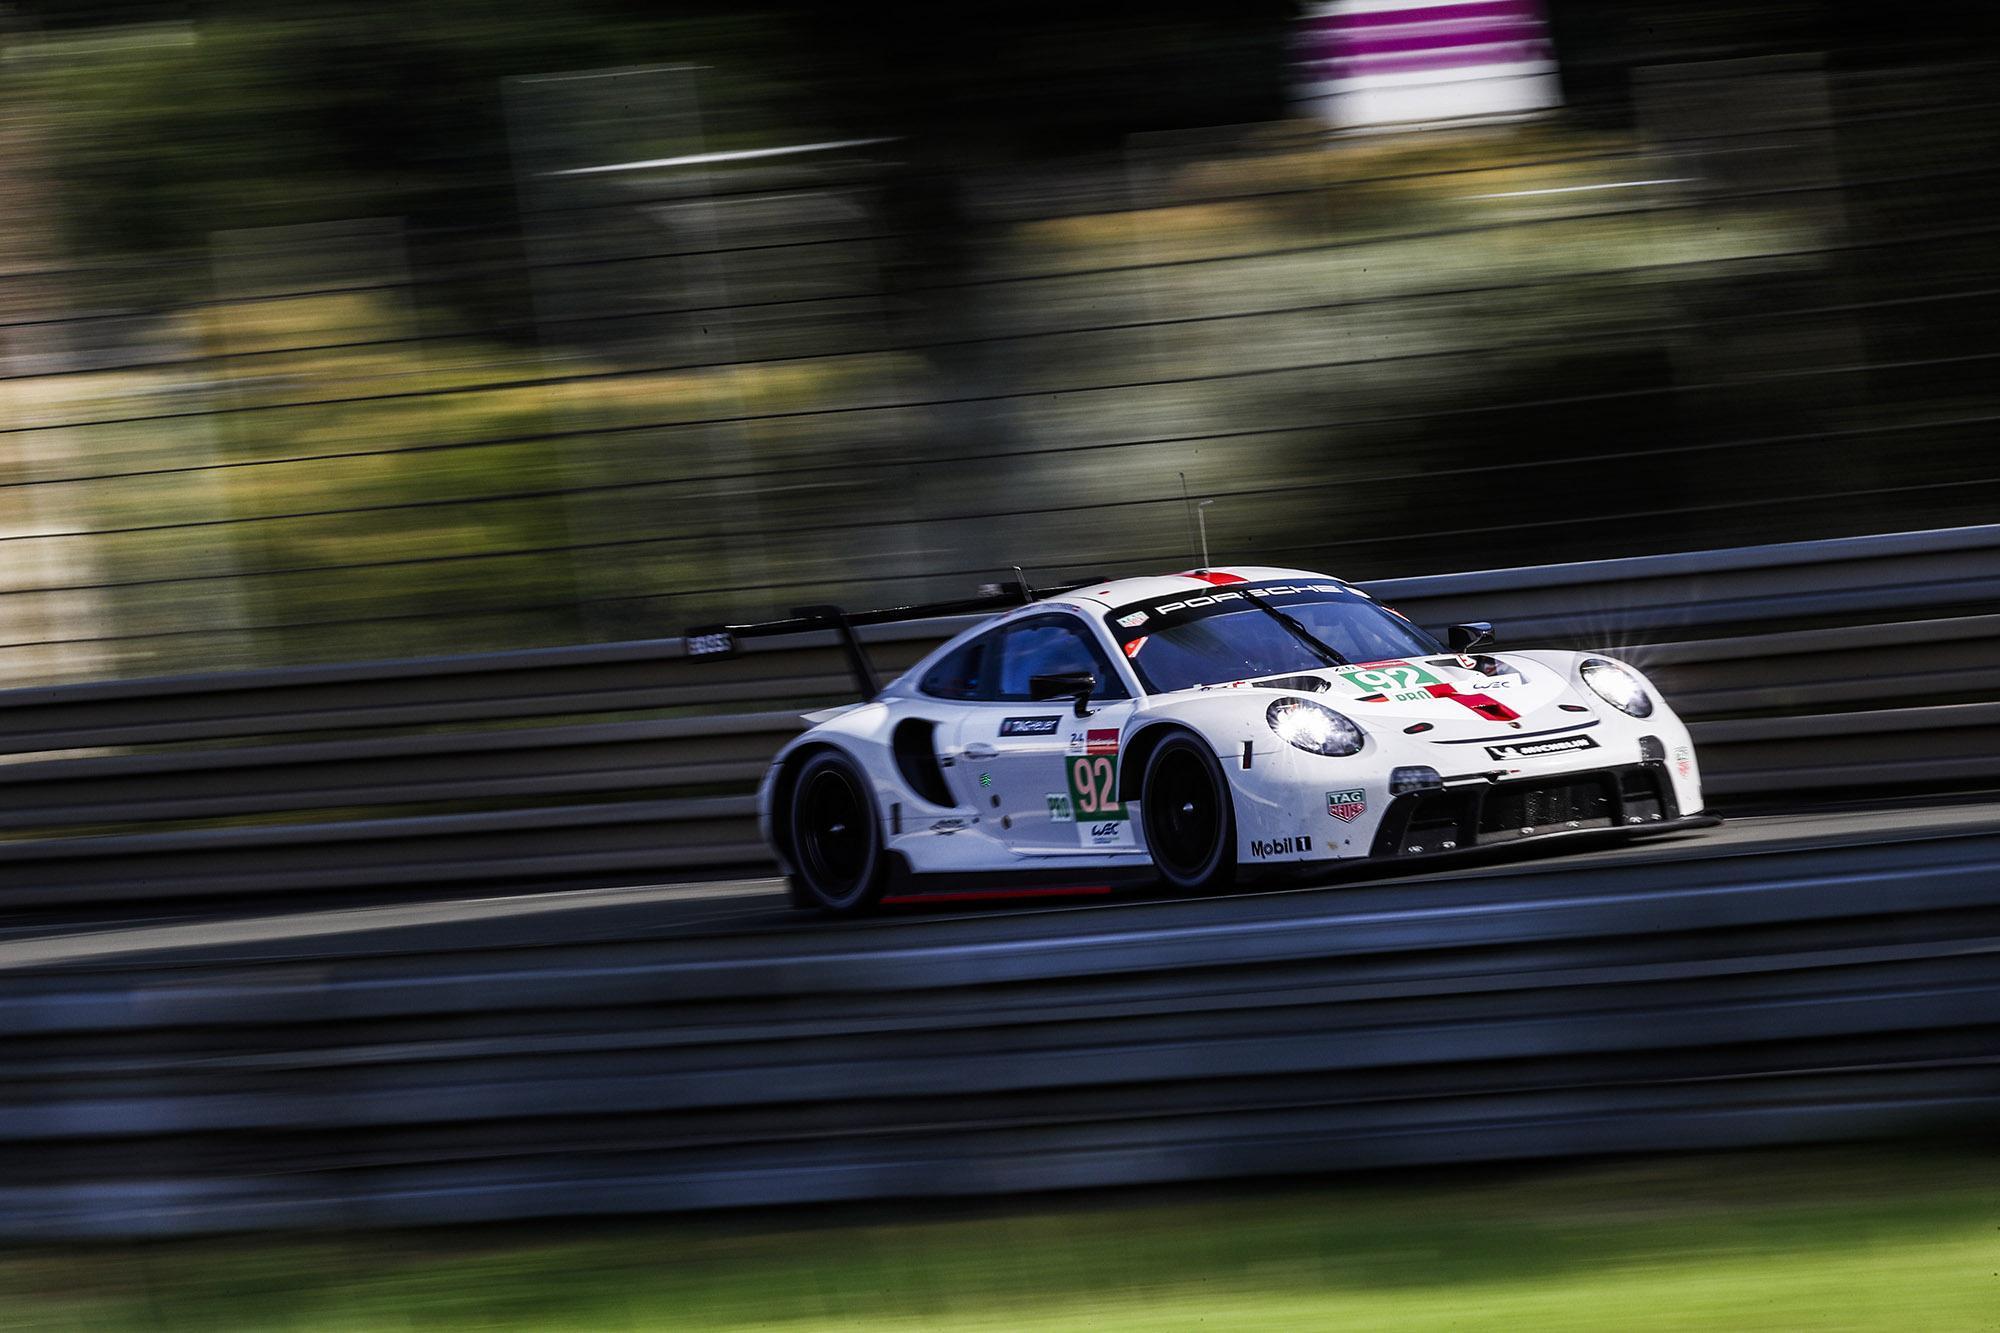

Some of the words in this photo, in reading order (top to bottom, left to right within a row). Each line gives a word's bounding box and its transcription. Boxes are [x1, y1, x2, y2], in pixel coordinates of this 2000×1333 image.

[1155, 584, 1344, 615] PORSCHE
[1354, 667, 1434, 693] 92
[1074, 757, 1120, 813] 92
[1331, 792, 1362, 804] TAG
[1092, 823, 1120, 838] WEC
[1251, 837, 1293, 859] Mobil
